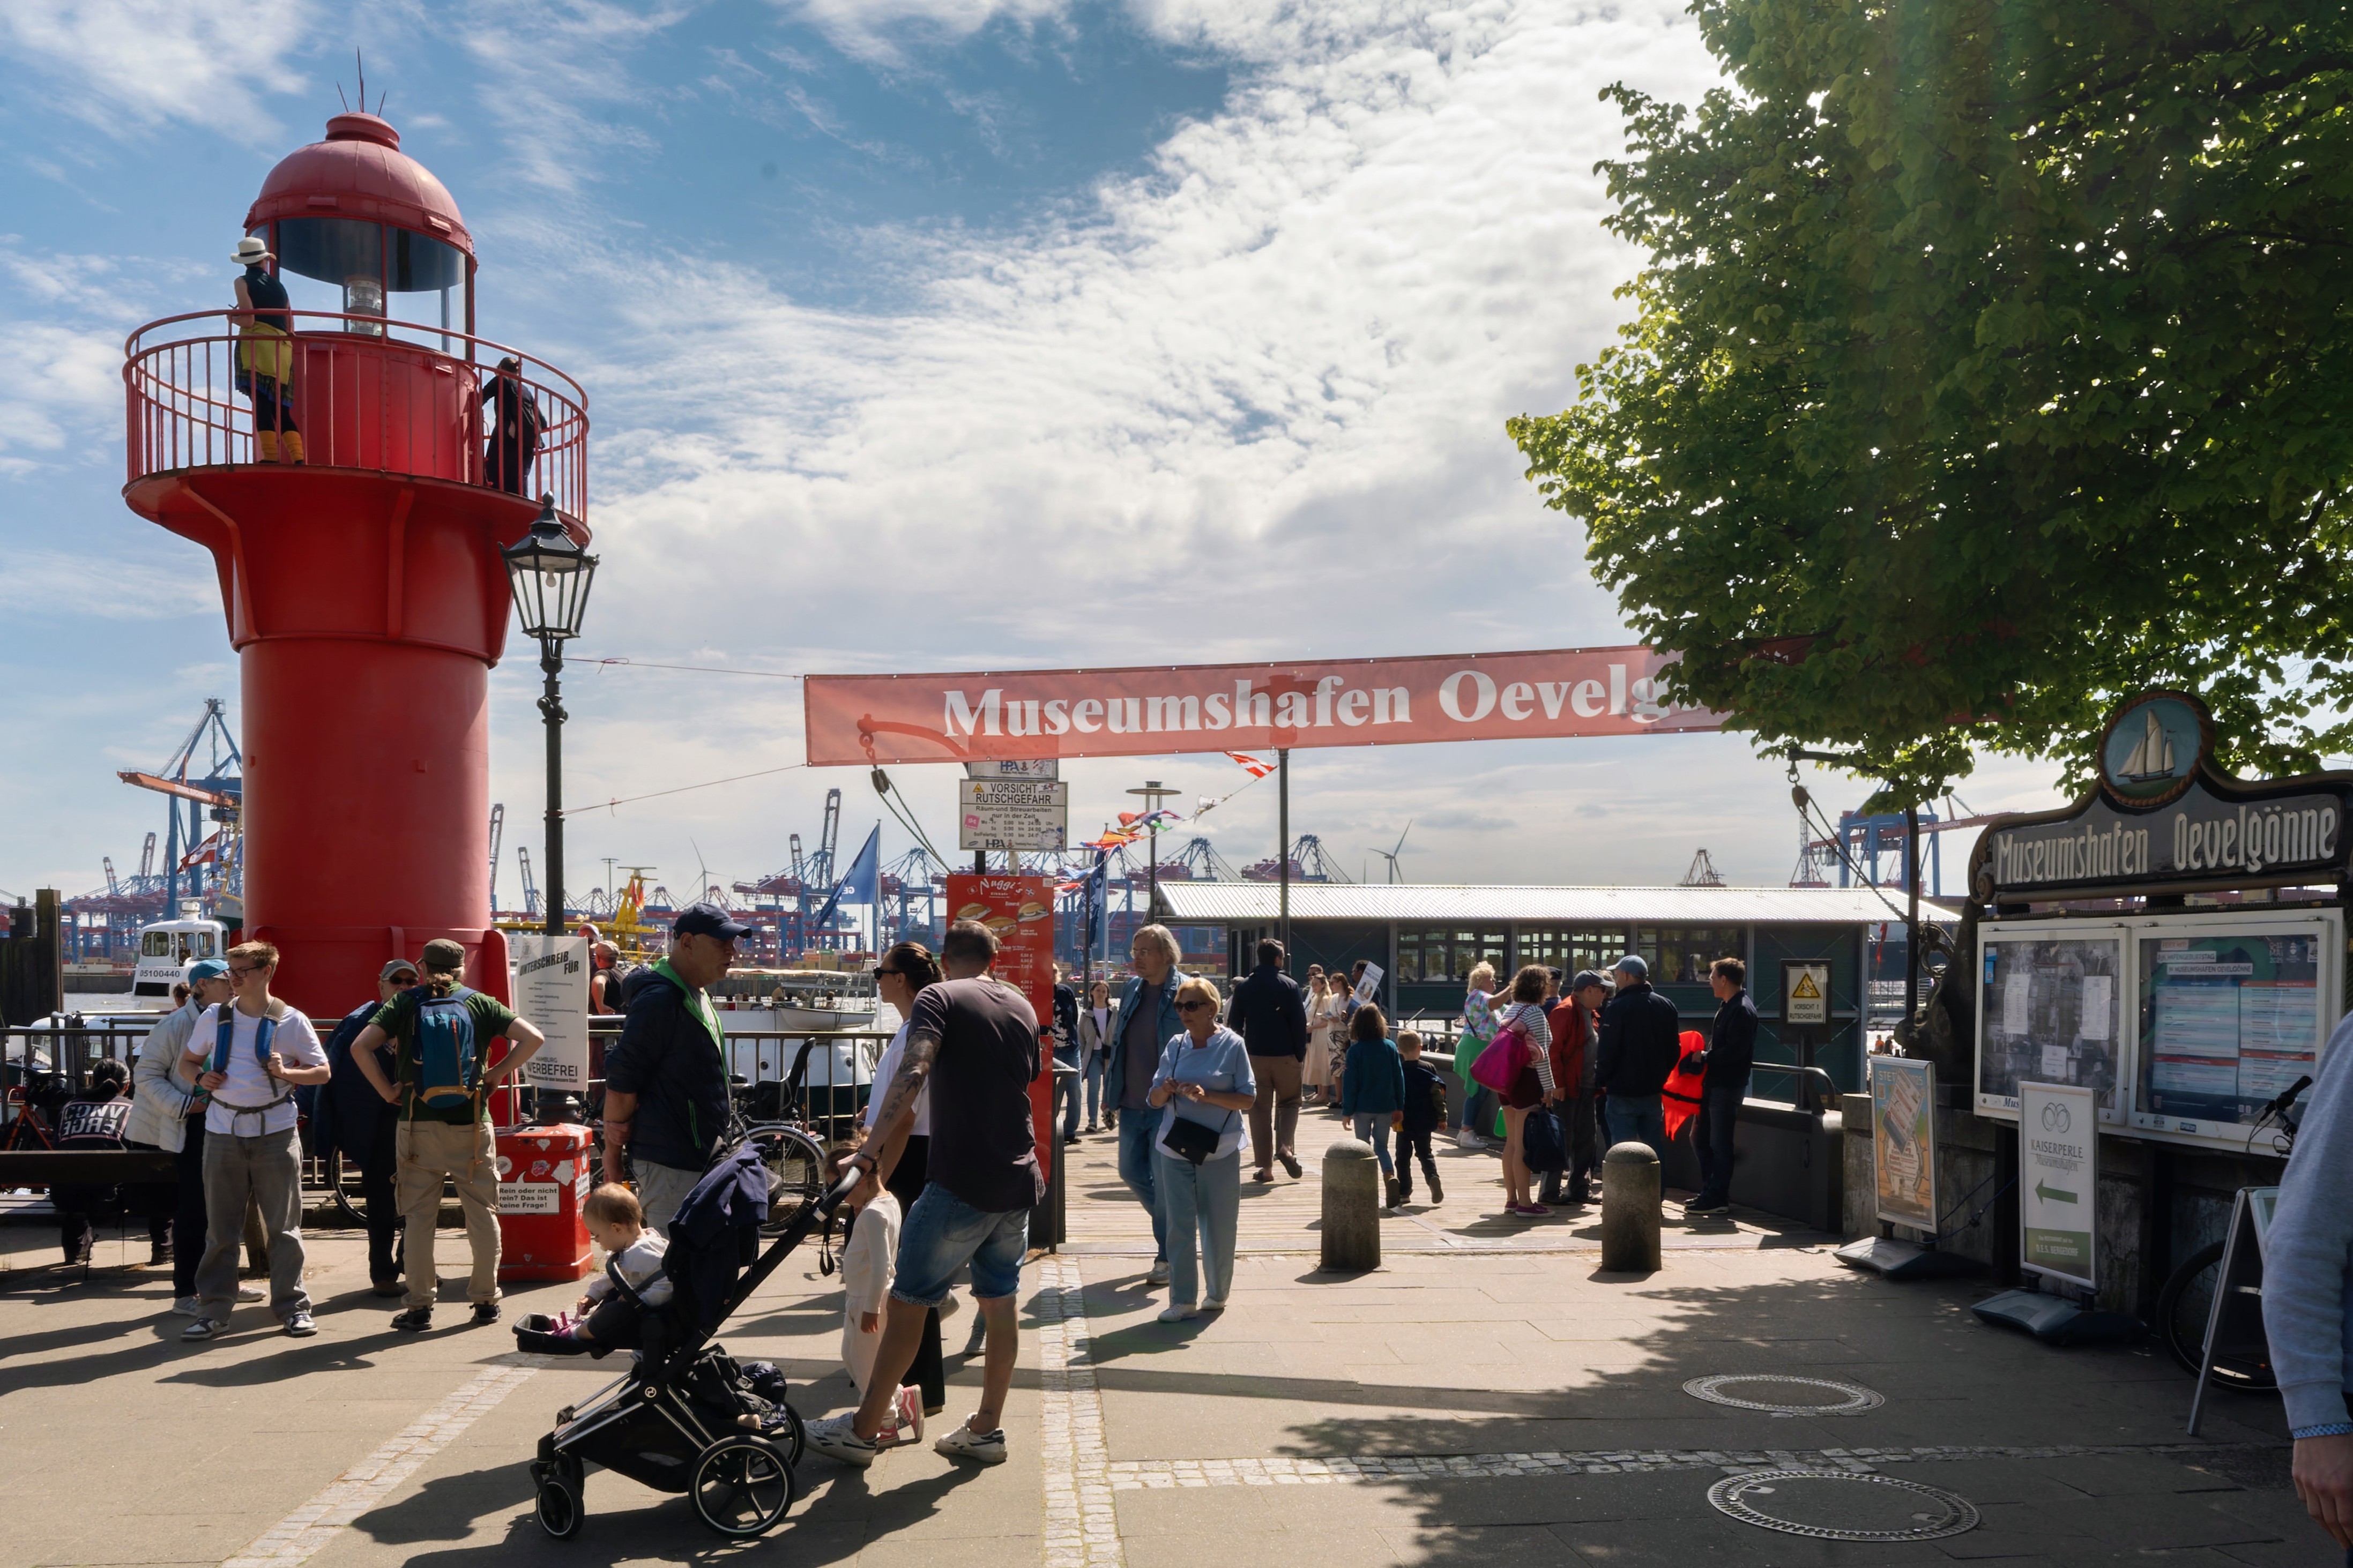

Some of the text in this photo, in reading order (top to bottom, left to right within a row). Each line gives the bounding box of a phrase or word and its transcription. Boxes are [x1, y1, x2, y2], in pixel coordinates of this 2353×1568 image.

[943, 663, 1704, 737] Museumshafen Oevelg
[991, 783, 1037, 793] VORSICHT
[976, 793, 1051, 804] RUTSCHGEFAHR
[986, 839, 1006, 848] HPA
[1995, 804, 2336, 885] Museumshafen Oevelgönne
[519, 951, 569, 976] UNTERSCHREIB
[564, 960, 579, 975] FÜR
[140, 969, 180, 977] 05100440
[526, 1062, 578, 1077] WERBEFREI
[2030, 1139, 2084, 1159] KAISERPERLE
